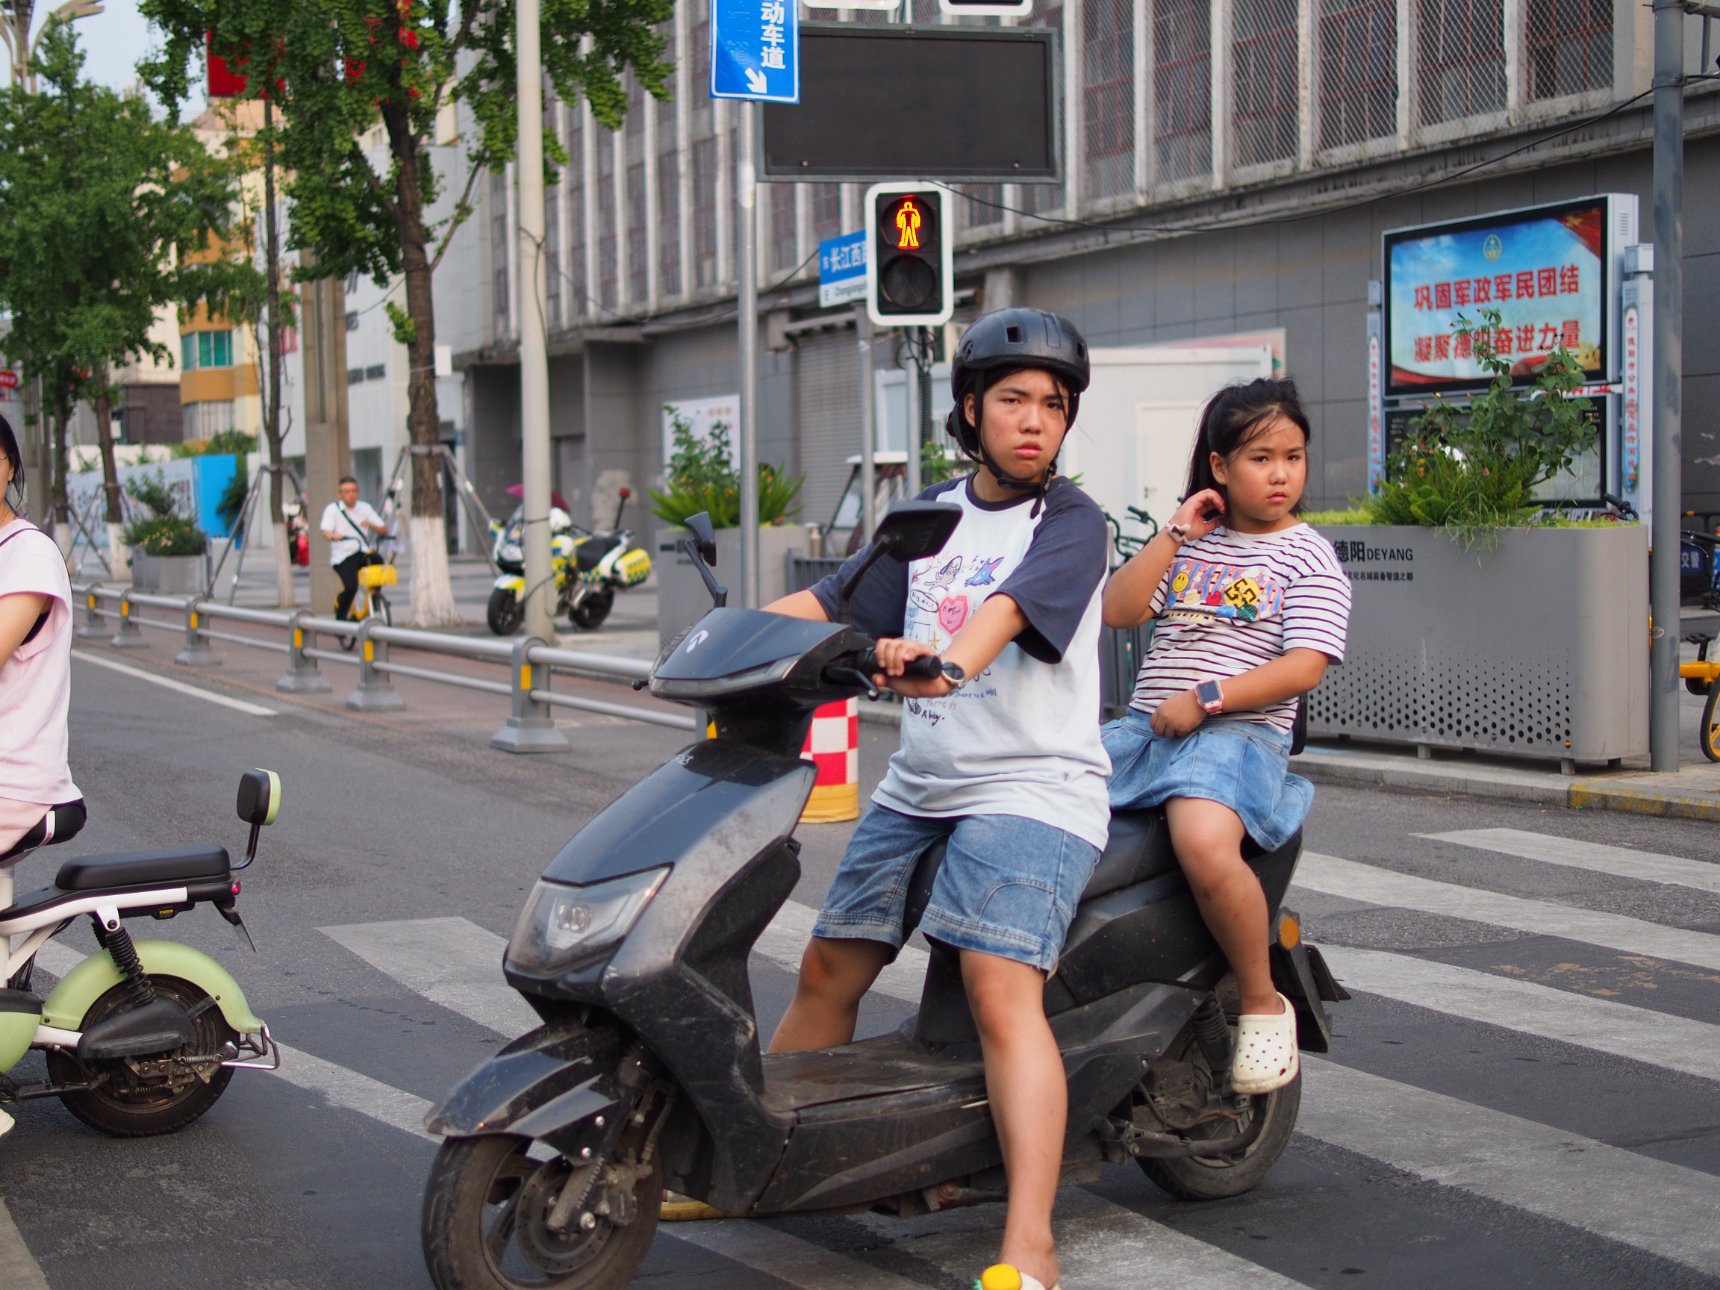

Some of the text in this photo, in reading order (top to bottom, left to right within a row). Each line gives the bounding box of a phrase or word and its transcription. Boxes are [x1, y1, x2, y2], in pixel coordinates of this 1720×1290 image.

[760, 0, 786, 70] 动车道
[1413, 263, 1580, 312] 巩固军政军民团结
[1333, 539, 1413, 563] 德阳 DEYANG
